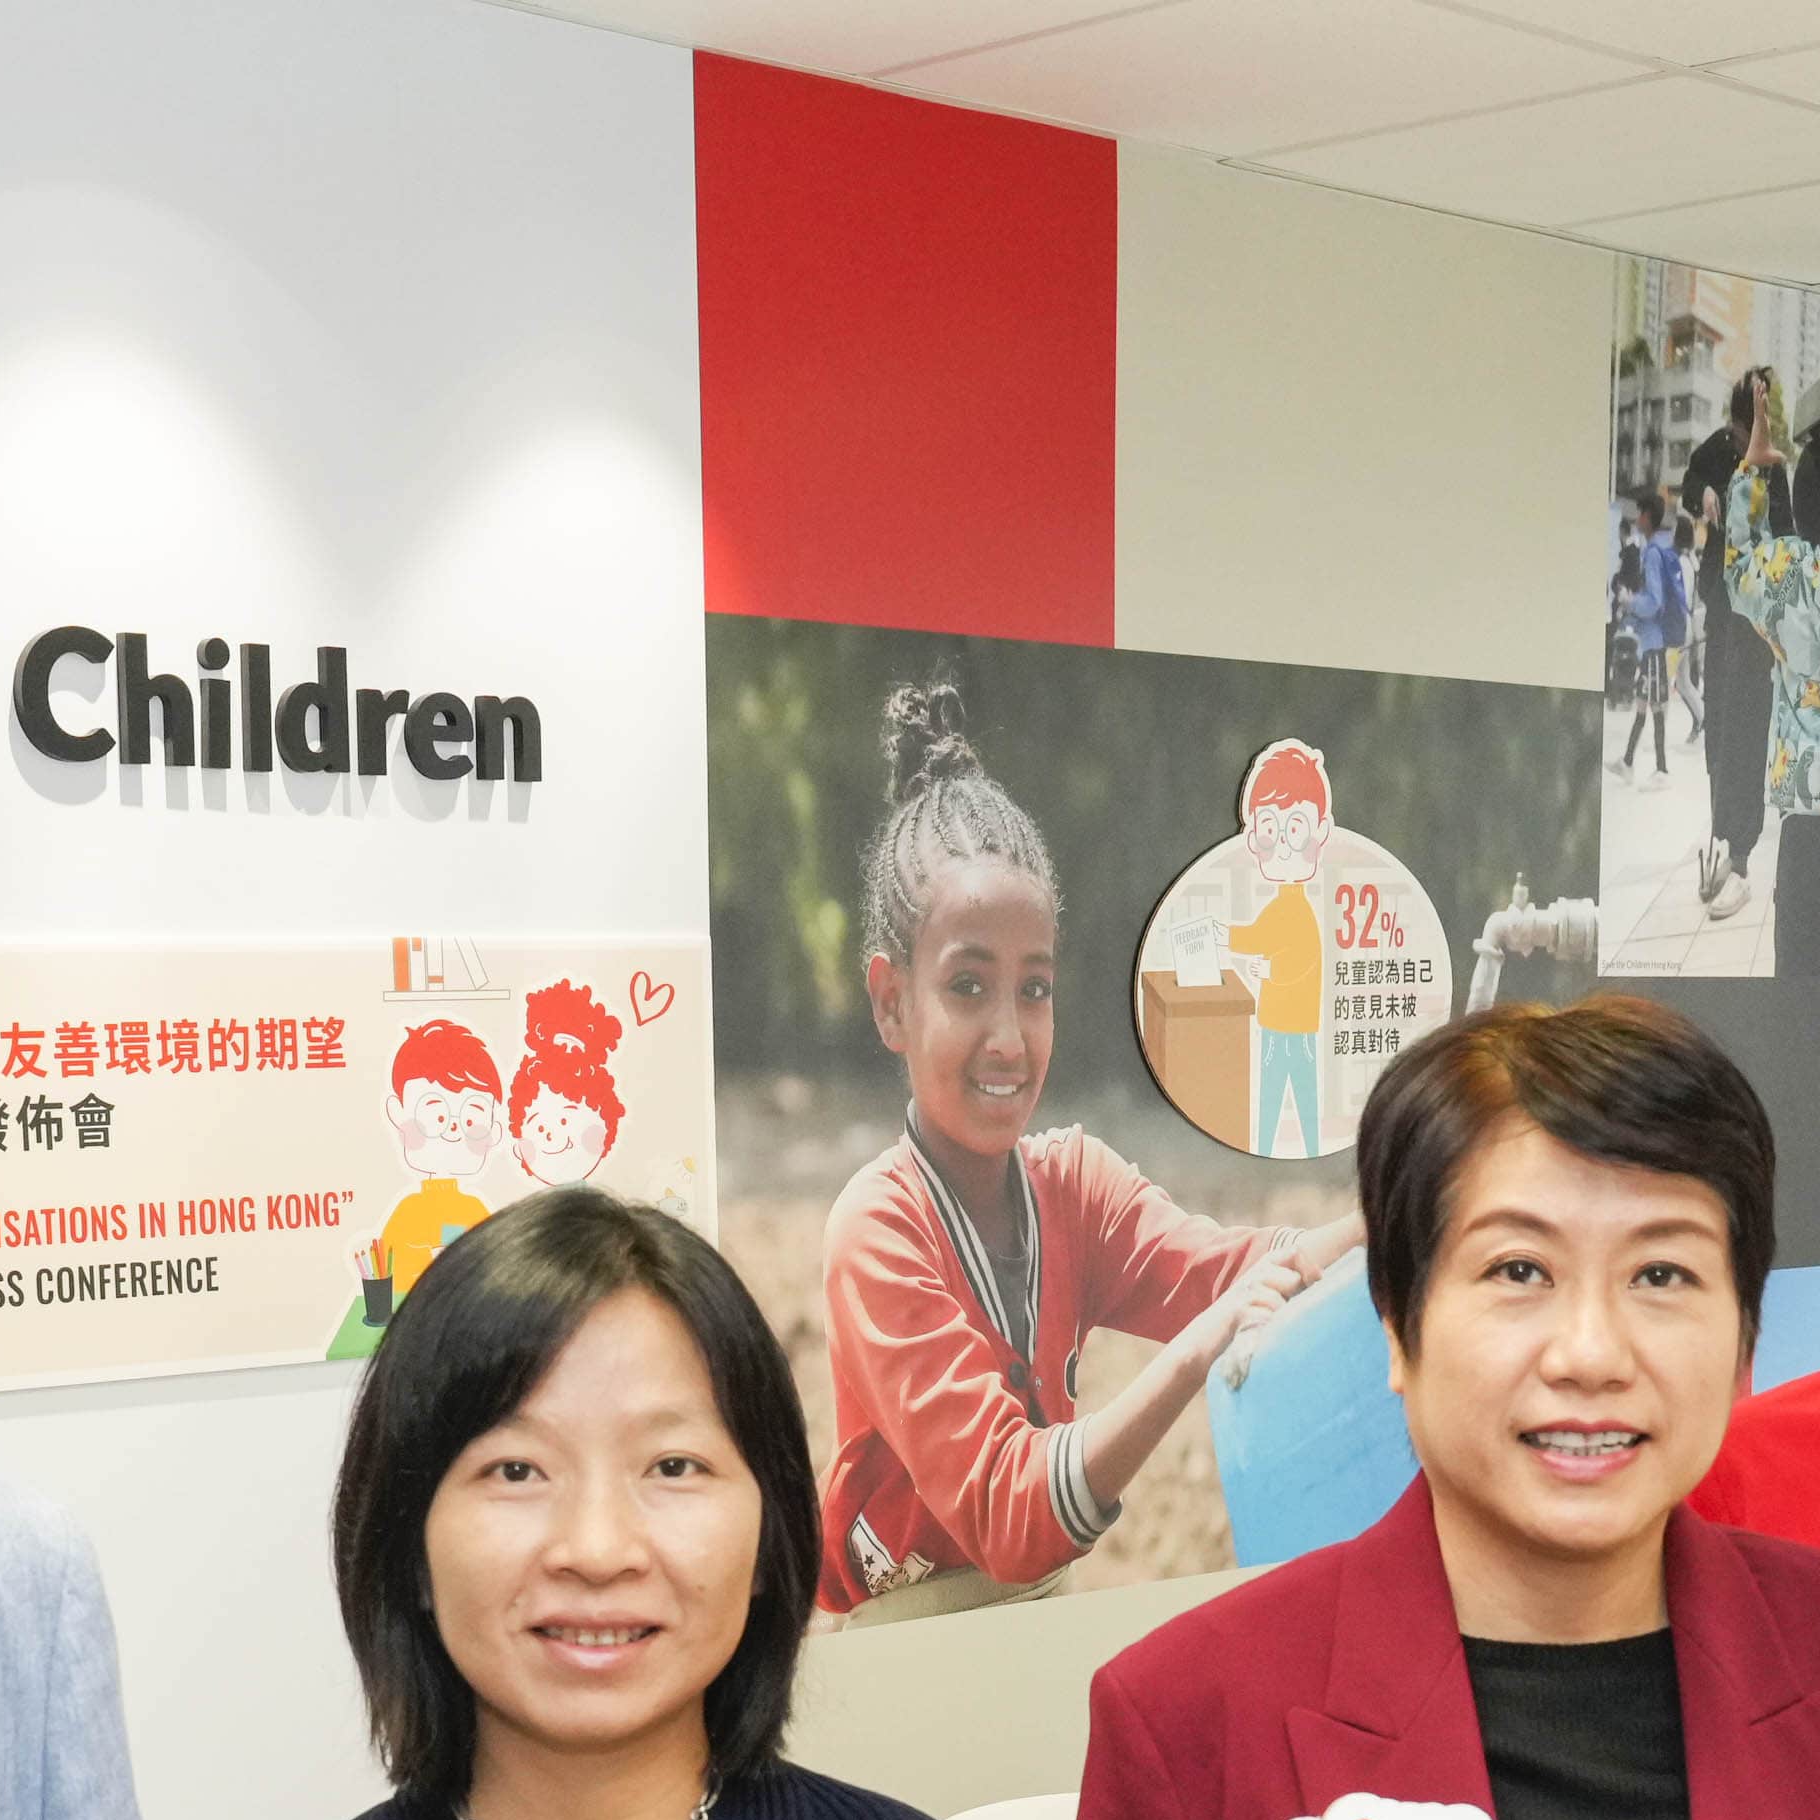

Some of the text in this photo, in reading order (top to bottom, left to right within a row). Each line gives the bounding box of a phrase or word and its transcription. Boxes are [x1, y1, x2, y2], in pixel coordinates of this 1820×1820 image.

[14, 625, 542, 782] Children
[1334, 884, 1405, 951] 32%
[1333, 958, 1434, 987] 兒童認為自己
[1333, 993, 1418, 1021] 的意見未被
[1333, 1028, 1401, 1056] 認真對待
[139, 1201, 166, 1239] IN
[178, 1195, 256, 1236] HONG
[267, 1190, 354, 1230] KONG”
[36, 1256, 219, 1304] CONFERENCE
